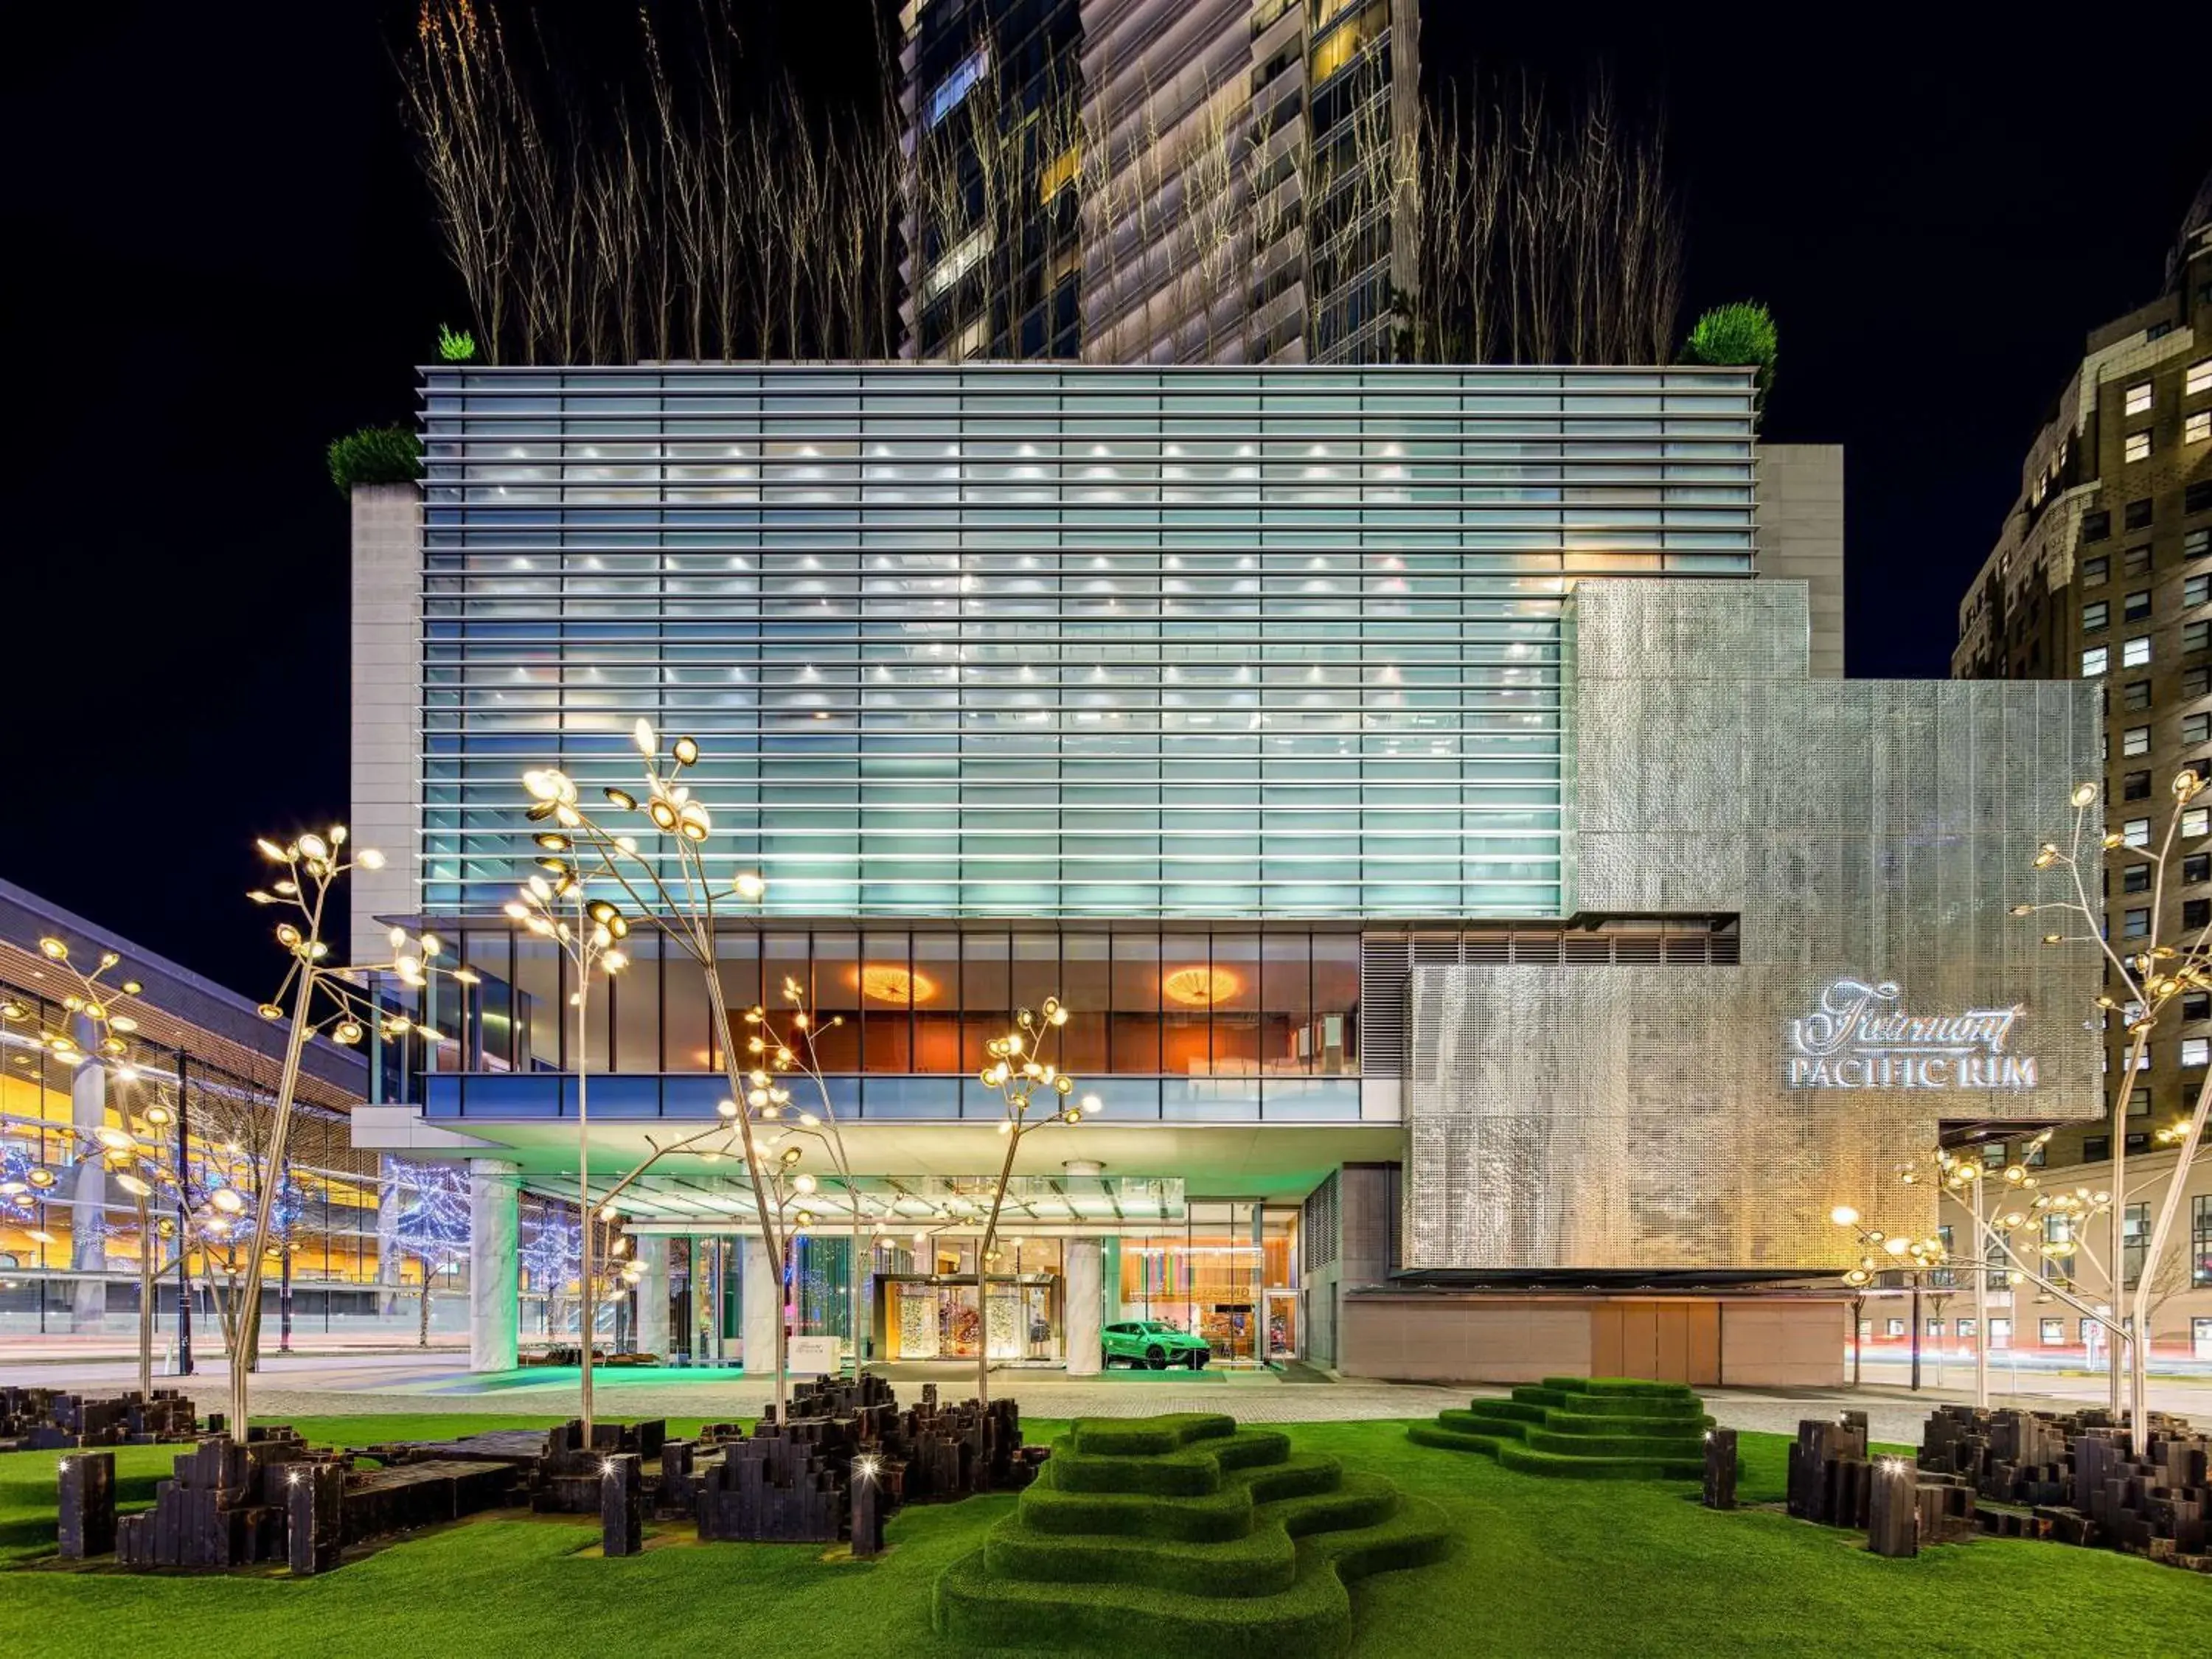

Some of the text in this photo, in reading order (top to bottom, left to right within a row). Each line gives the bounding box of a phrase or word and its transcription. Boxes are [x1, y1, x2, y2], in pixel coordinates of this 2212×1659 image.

[1795, 979, 2027, 1055] Fairmont
[1792, 1057, 2039, 1088] PACIFIC RIM
